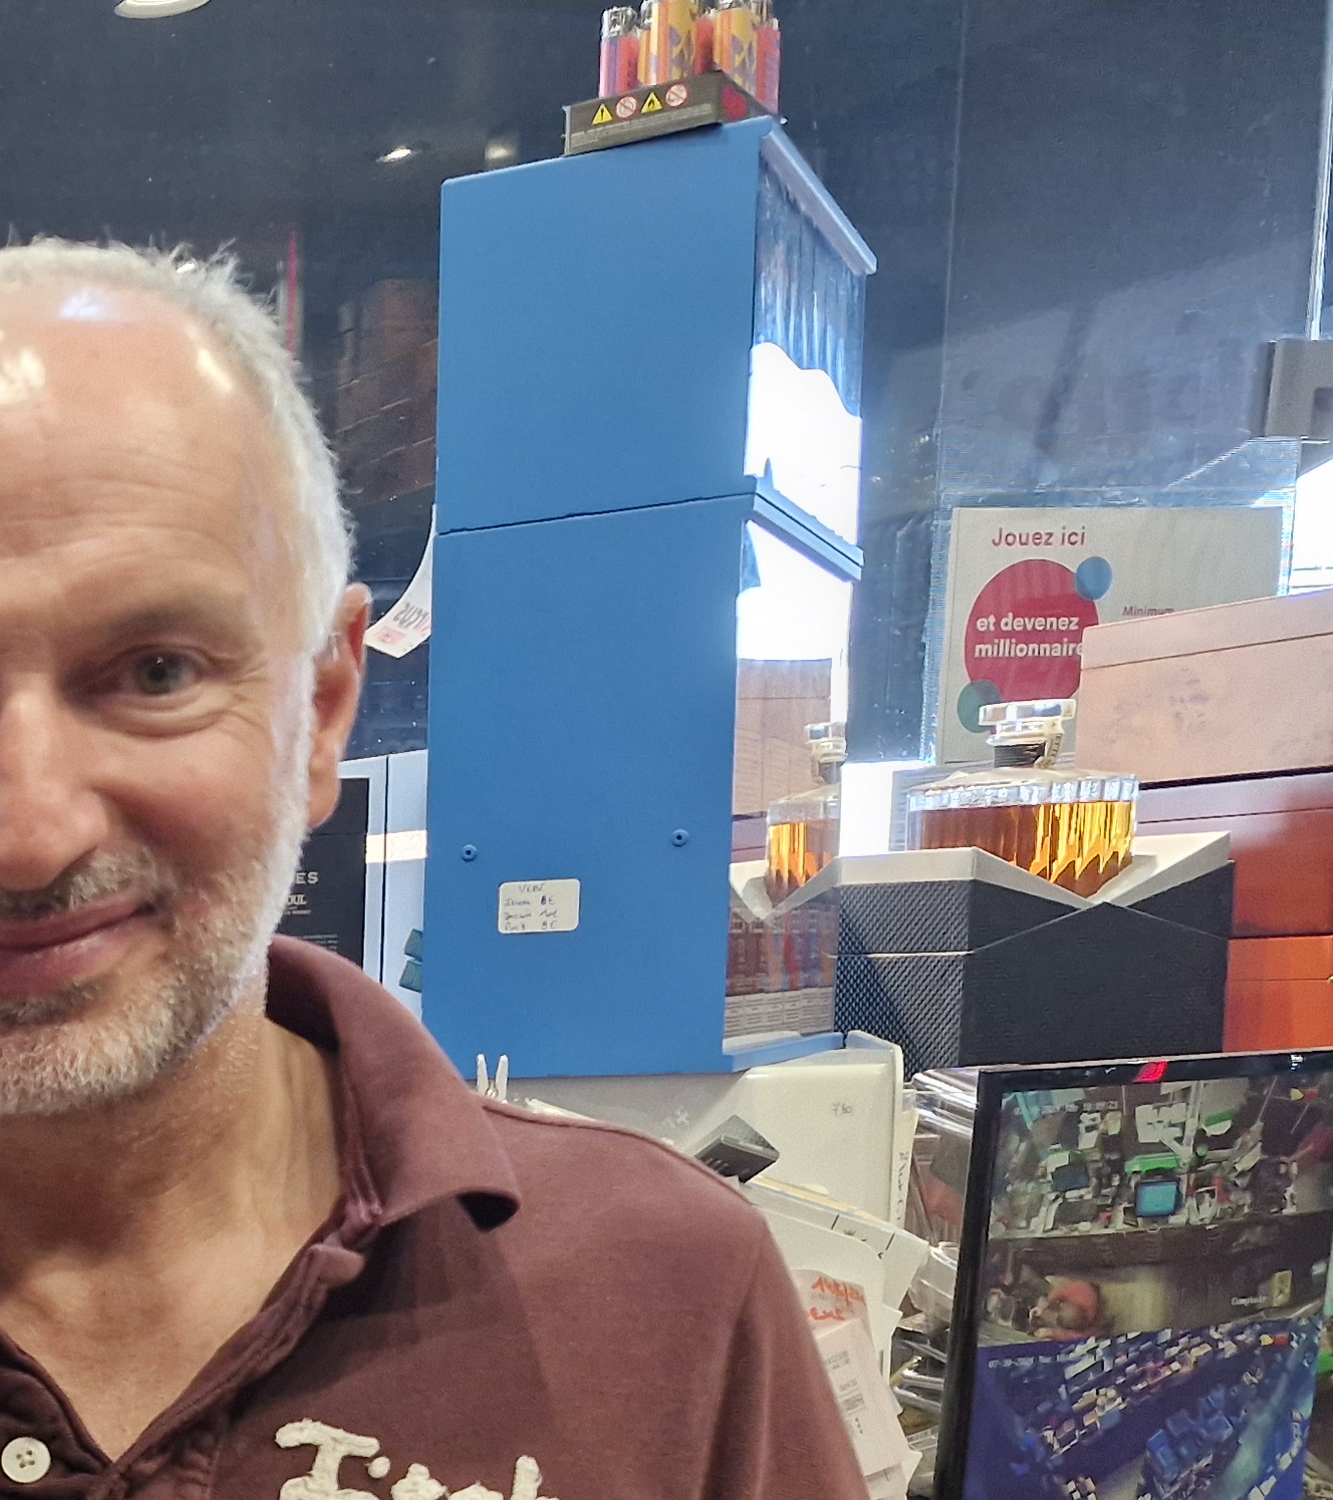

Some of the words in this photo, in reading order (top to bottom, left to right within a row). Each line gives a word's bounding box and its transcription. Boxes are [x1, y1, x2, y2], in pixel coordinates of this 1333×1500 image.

[992, 527, 1054, 547] Jouez
[1061, 526, 1086, 546] ici
[976, 615, 996, 632] et
[1000, 612, 1079, 631] devenez
